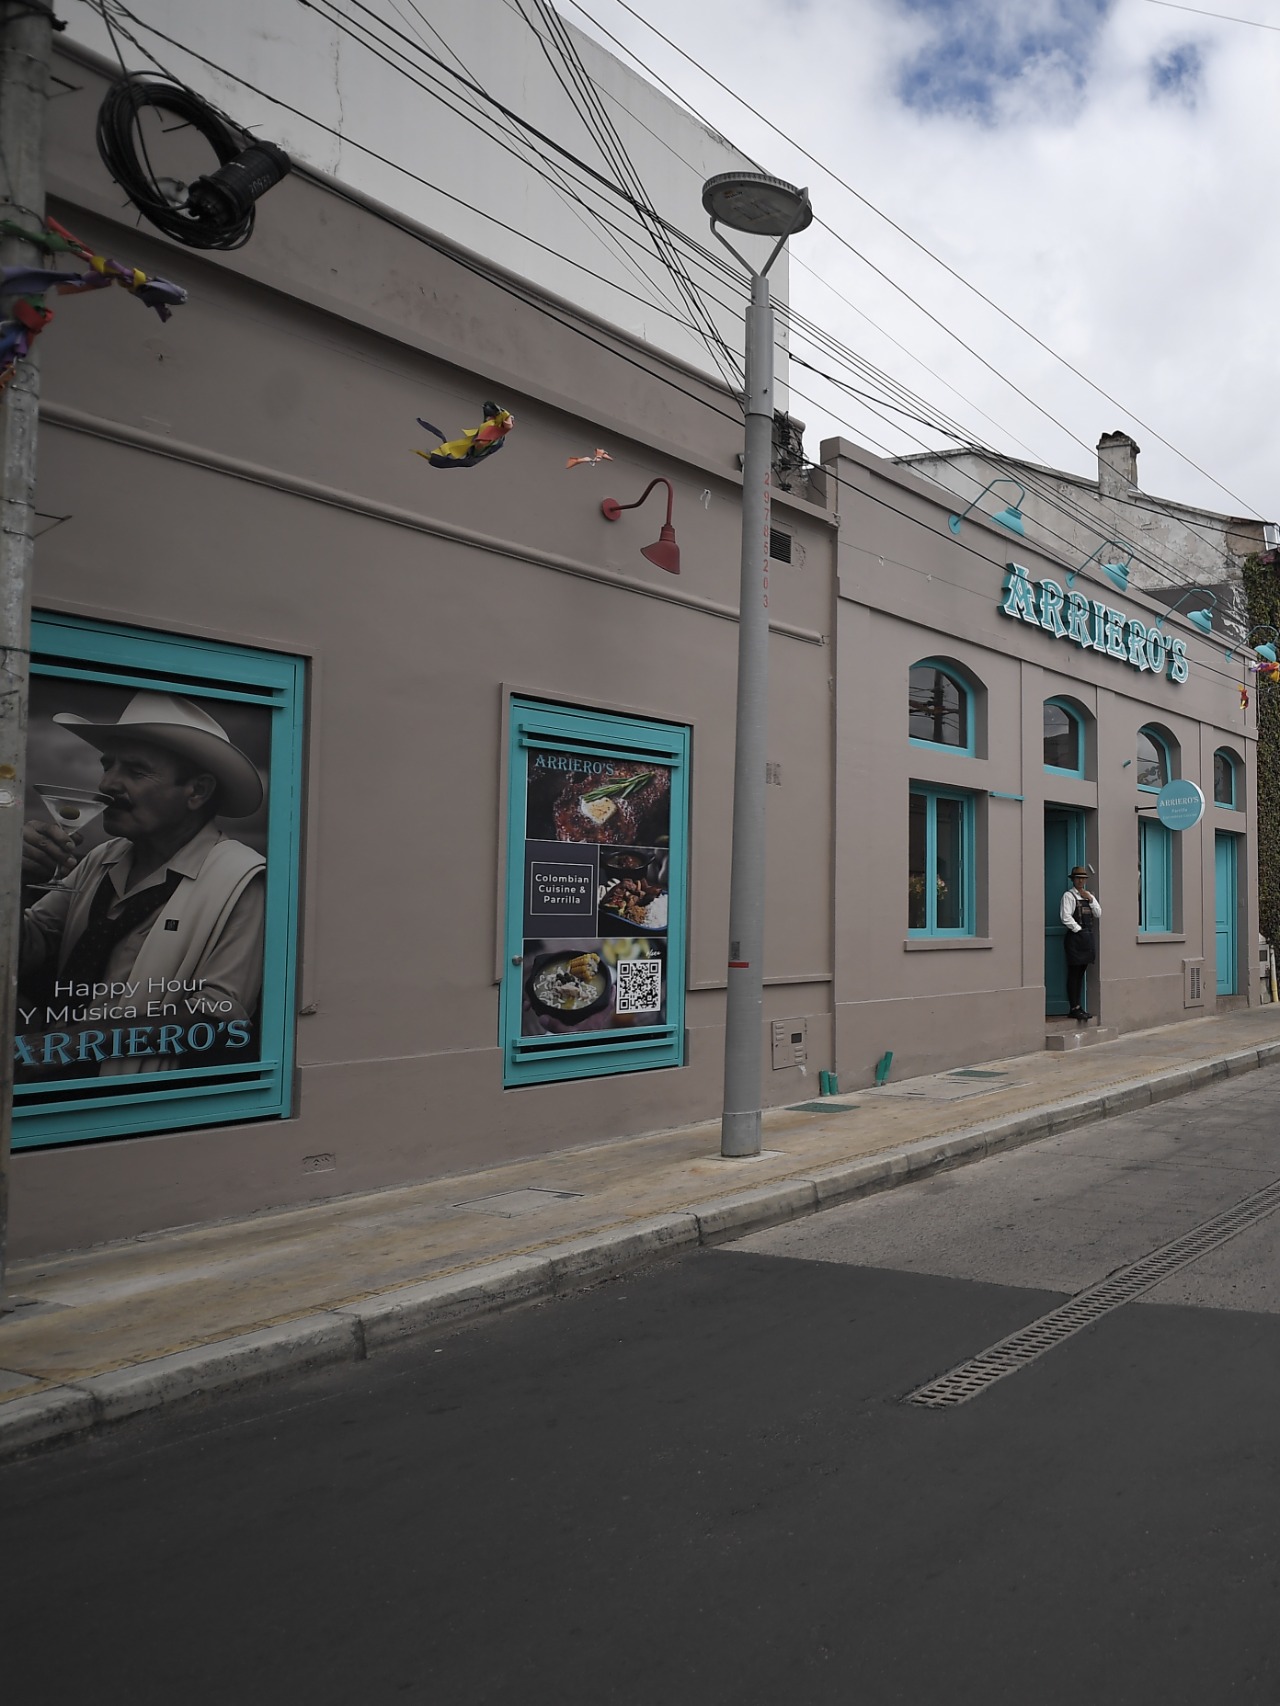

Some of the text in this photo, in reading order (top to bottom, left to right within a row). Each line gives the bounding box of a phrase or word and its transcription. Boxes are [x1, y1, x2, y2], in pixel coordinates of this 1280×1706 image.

[1000, 562, 1190, 684] ARRIERO'S
[534, 754, 615, 776] ARRIERO'S
[1159, 796, 1199, 807] ARRIERO'S
[535, 874, 589, 884] Colombian
[537, 885, 587, 894] Cuisine &
[543, 894, 581, 904] Parrilla
[54, 977, 207, 1000] Happy Hour
[18, 997, 234, 1025] Y Música En Vivo
[14, 1019, 251, 1066] ARRIERO'S
